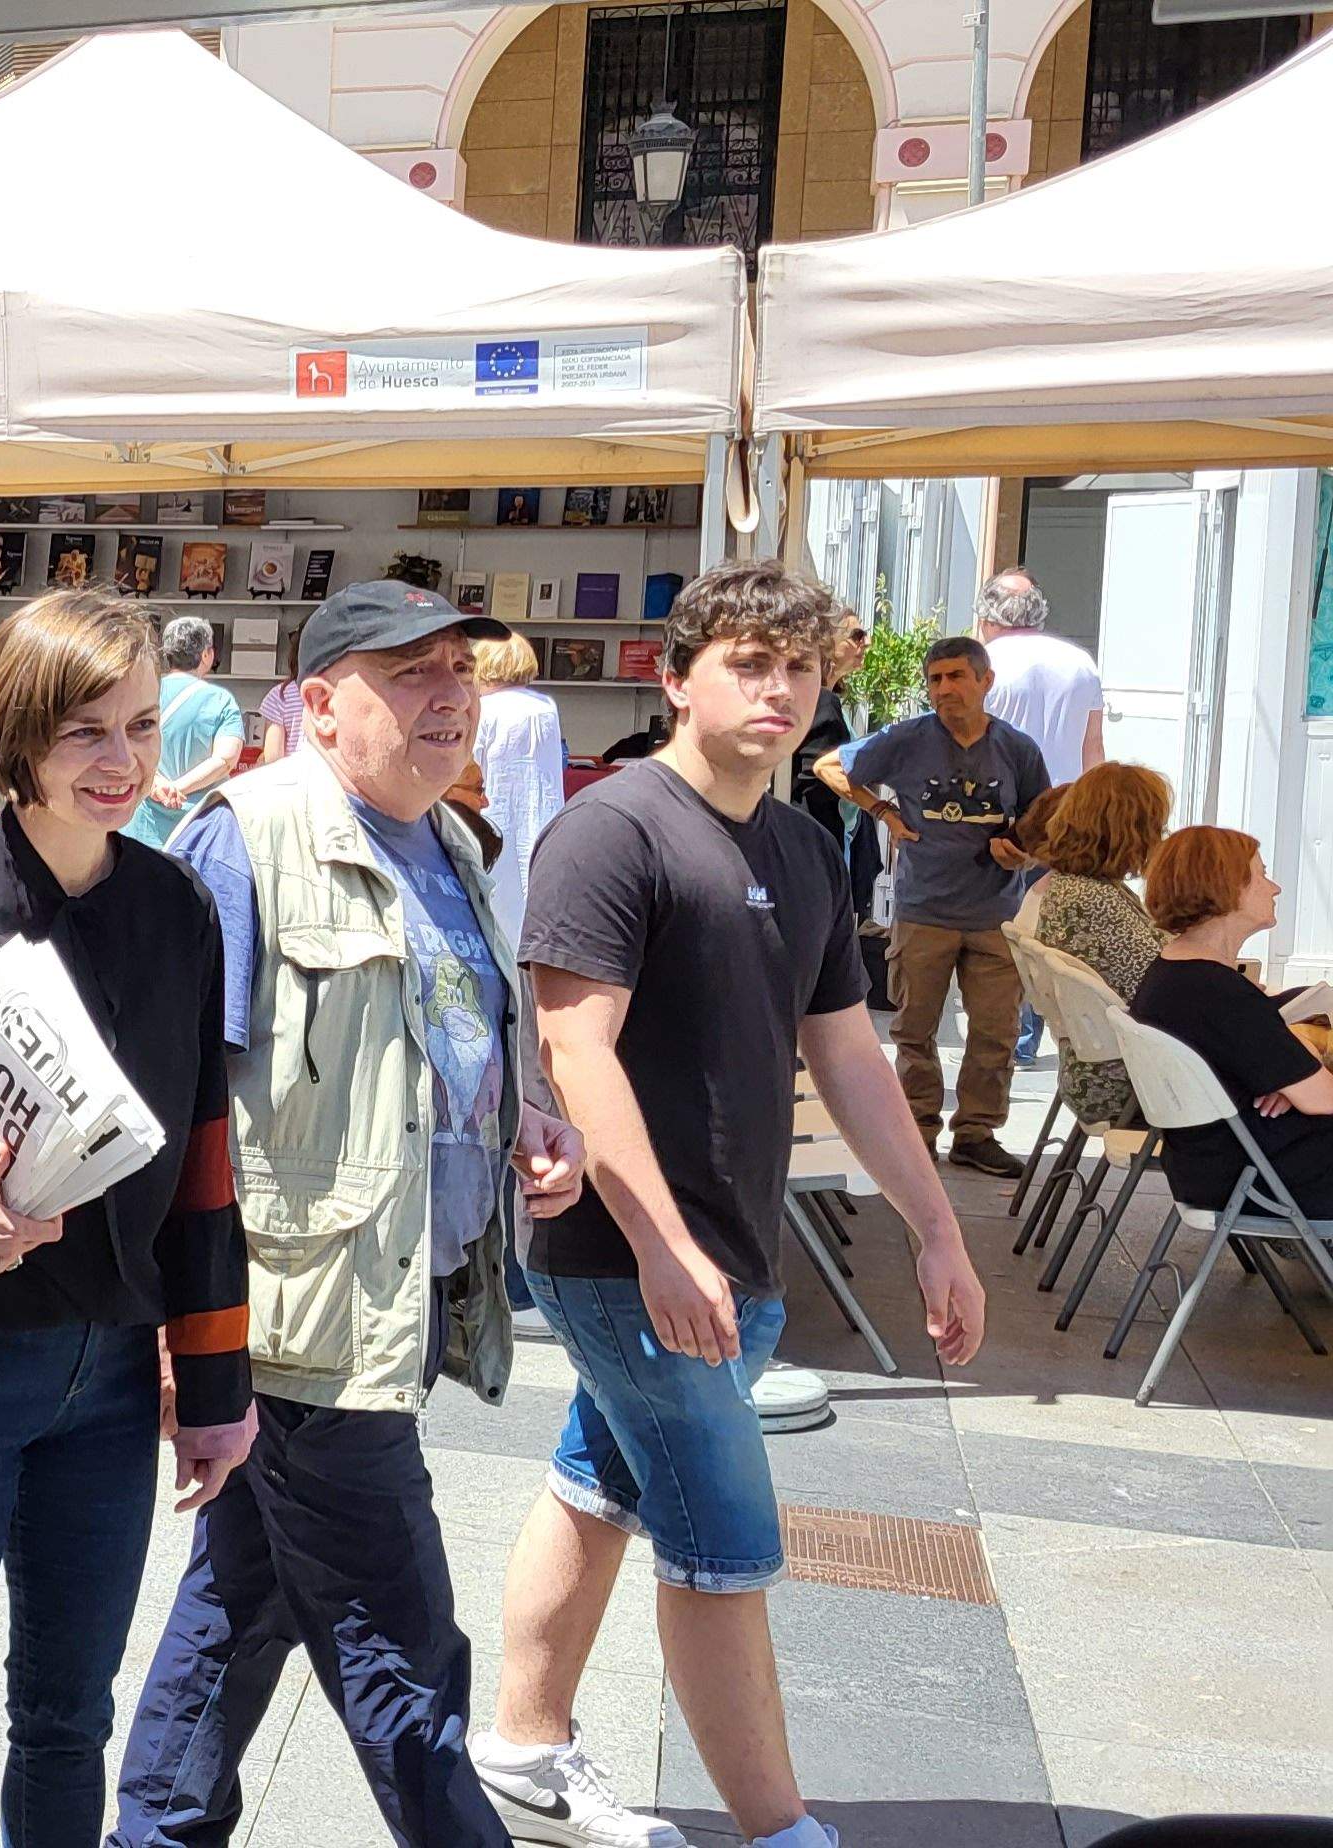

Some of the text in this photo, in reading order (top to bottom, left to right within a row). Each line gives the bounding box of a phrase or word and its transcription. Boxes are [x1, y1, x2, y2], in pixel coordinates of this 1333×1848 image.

[358, 357, 464, 376] Ayuntamiento
[358, 376, 439, 390] de Huesca
[418, 923, 486, 960] RIGH
